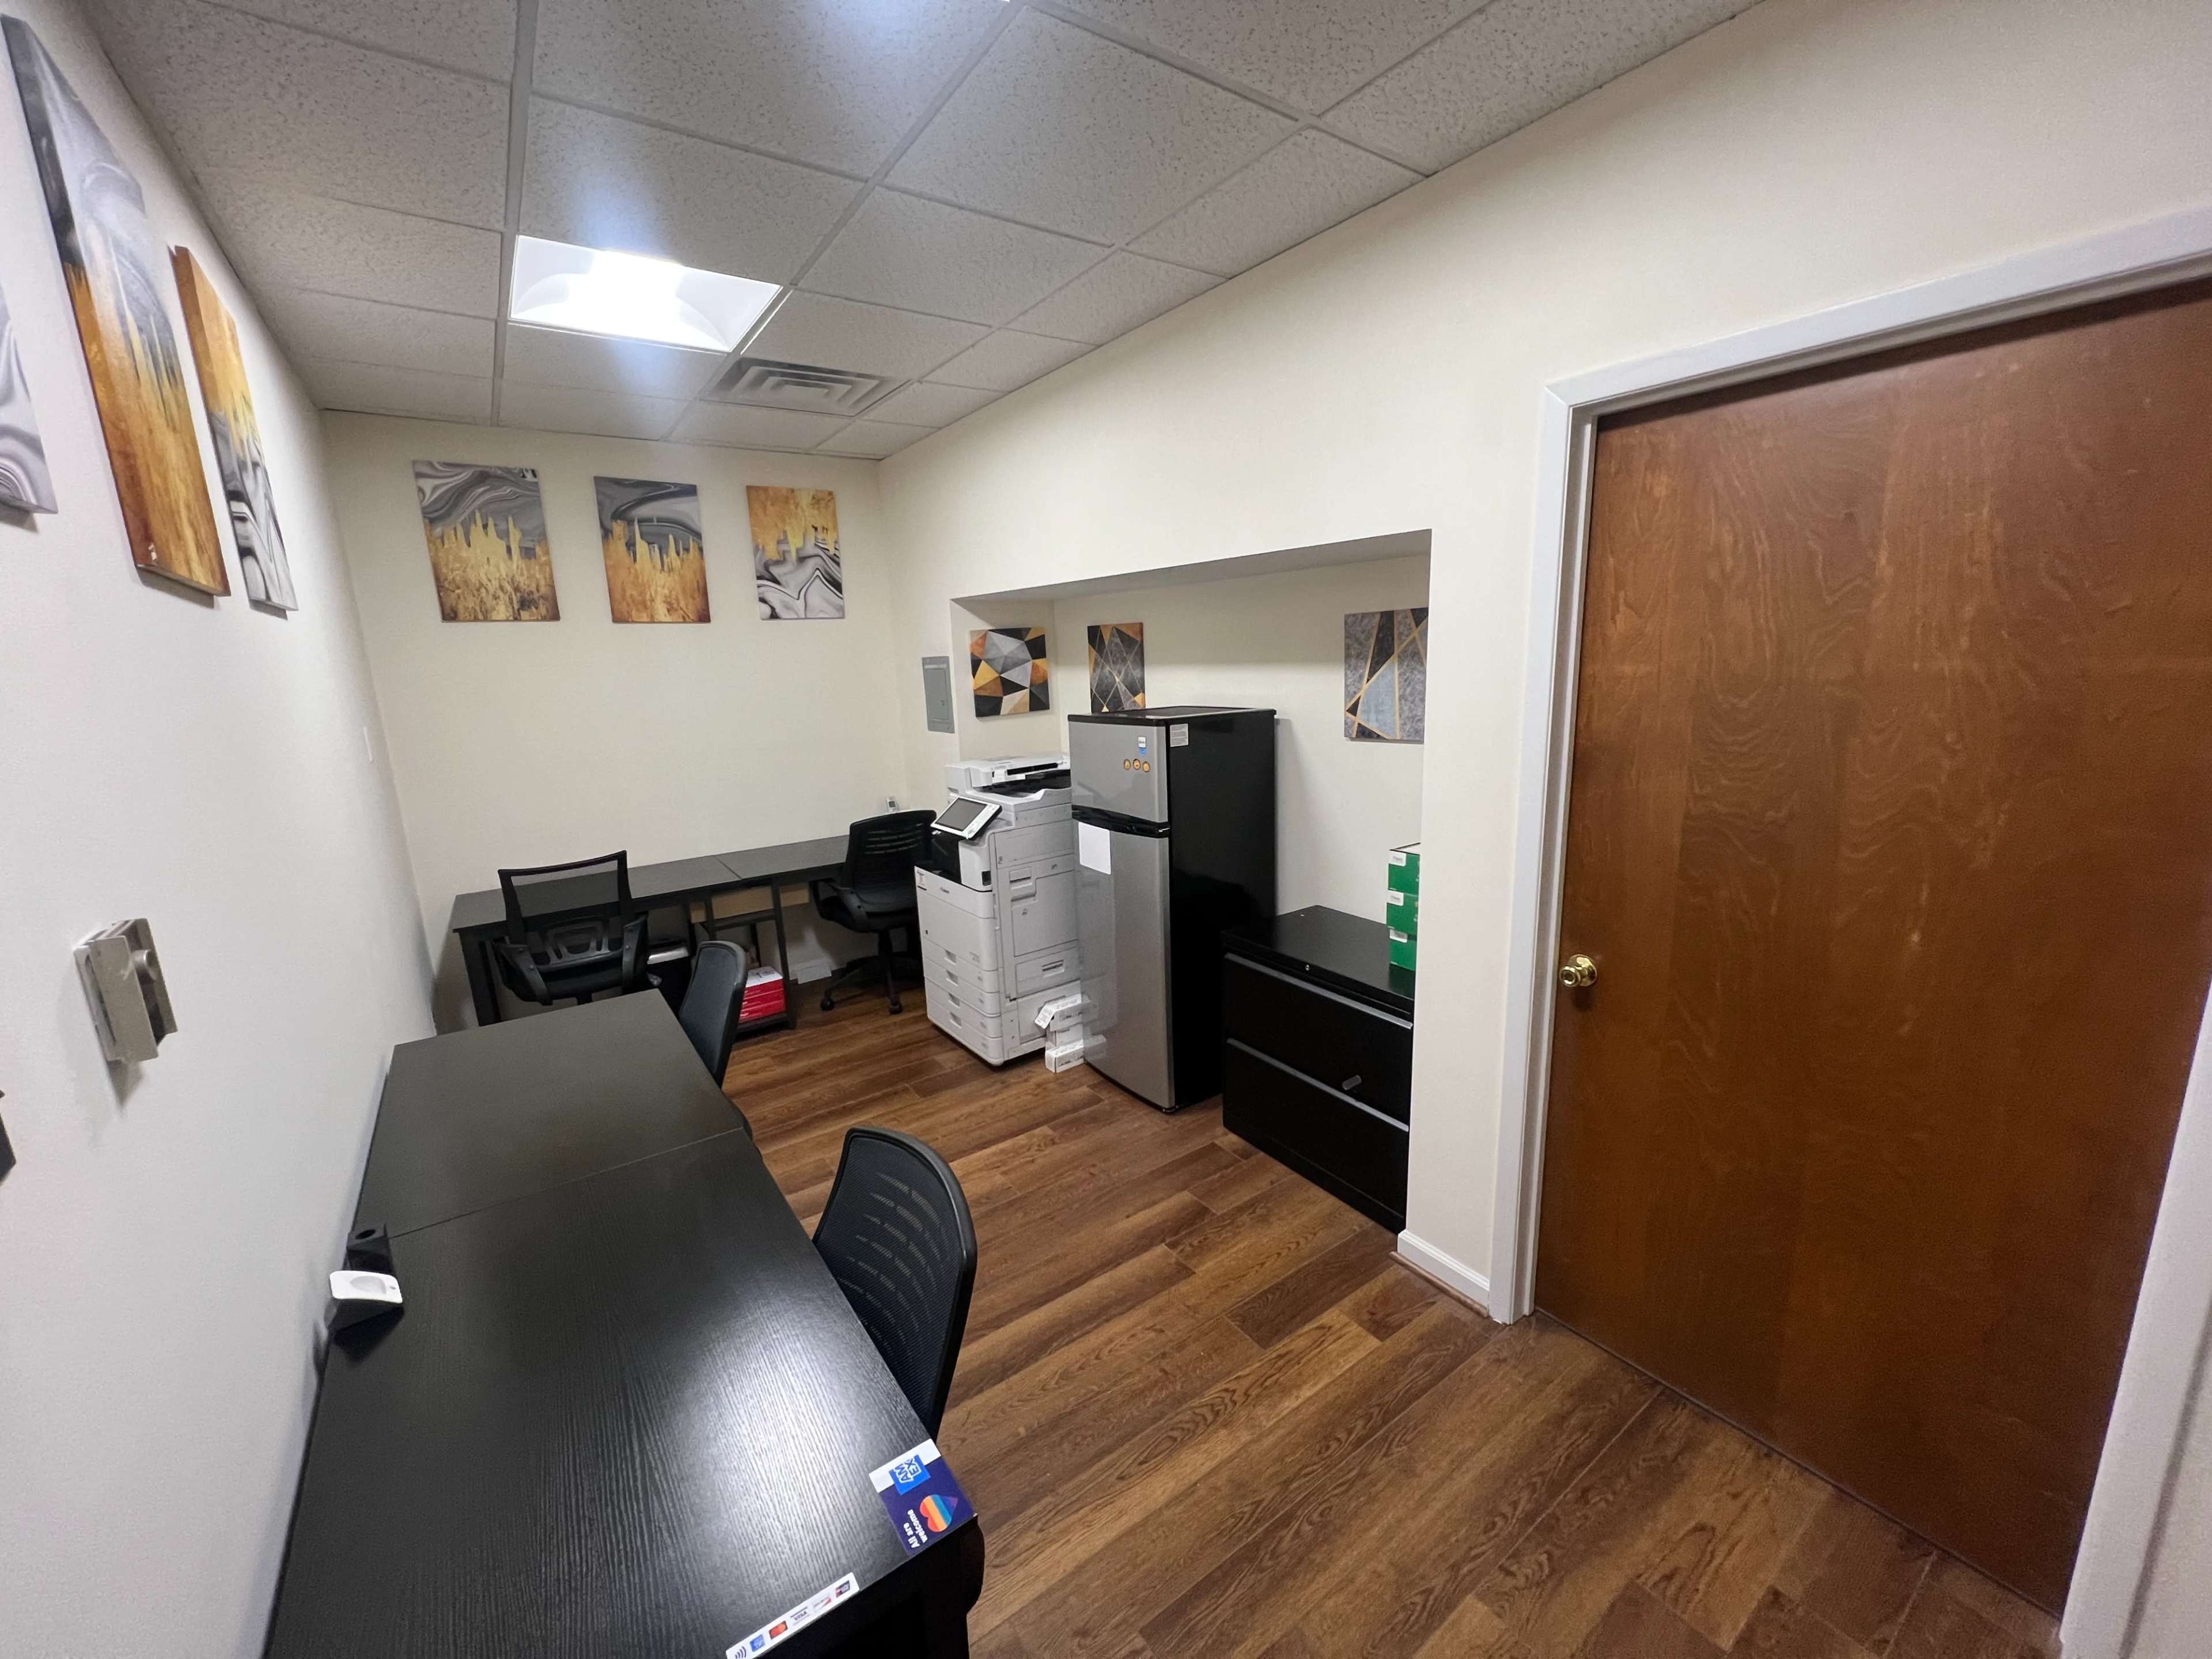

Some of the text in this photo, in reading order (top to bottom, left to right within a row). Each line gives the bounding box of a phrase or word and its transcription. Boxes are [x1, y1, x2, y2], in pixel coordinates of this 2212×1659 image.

[903, 1522, 921, 1548] All are
[907, 1509, 928, 1543] welcome
